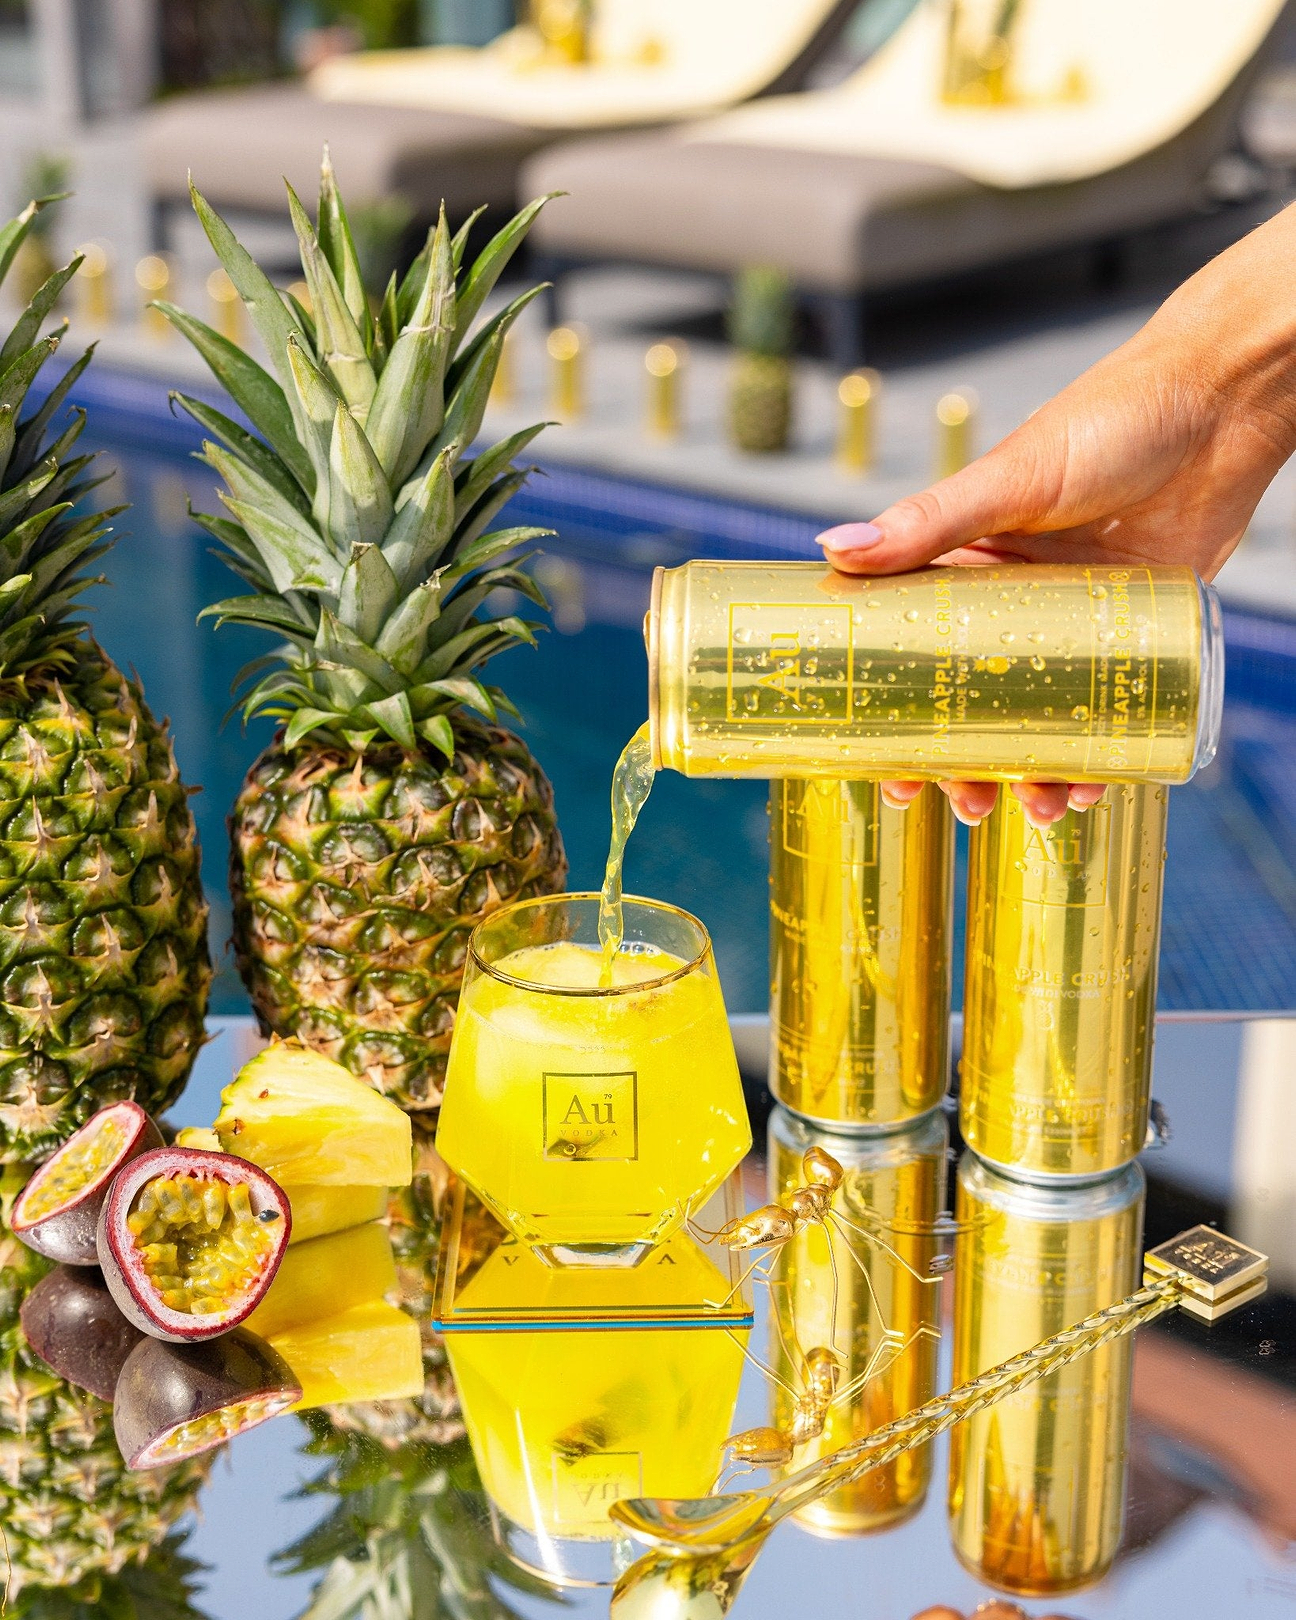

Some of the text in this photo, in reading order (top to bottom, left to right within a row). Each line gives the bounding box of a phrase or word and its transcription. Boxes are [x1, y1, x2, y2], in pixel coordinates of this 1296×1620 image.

[757, 630, 801, 705] Au
[932, 578, 953, 756] PINEAPPLE CRUSH
[1109, 582, 1132, 756] PINEAPPLE CRUSH
[956, 687, 968, 722] MADE
[1019, 827, 1084, 866] Au
[1071, 828, 1082, 837] 79
[559, 1094, 616, 1125] Au
[560, 1128, 618, 1138] VODKA
